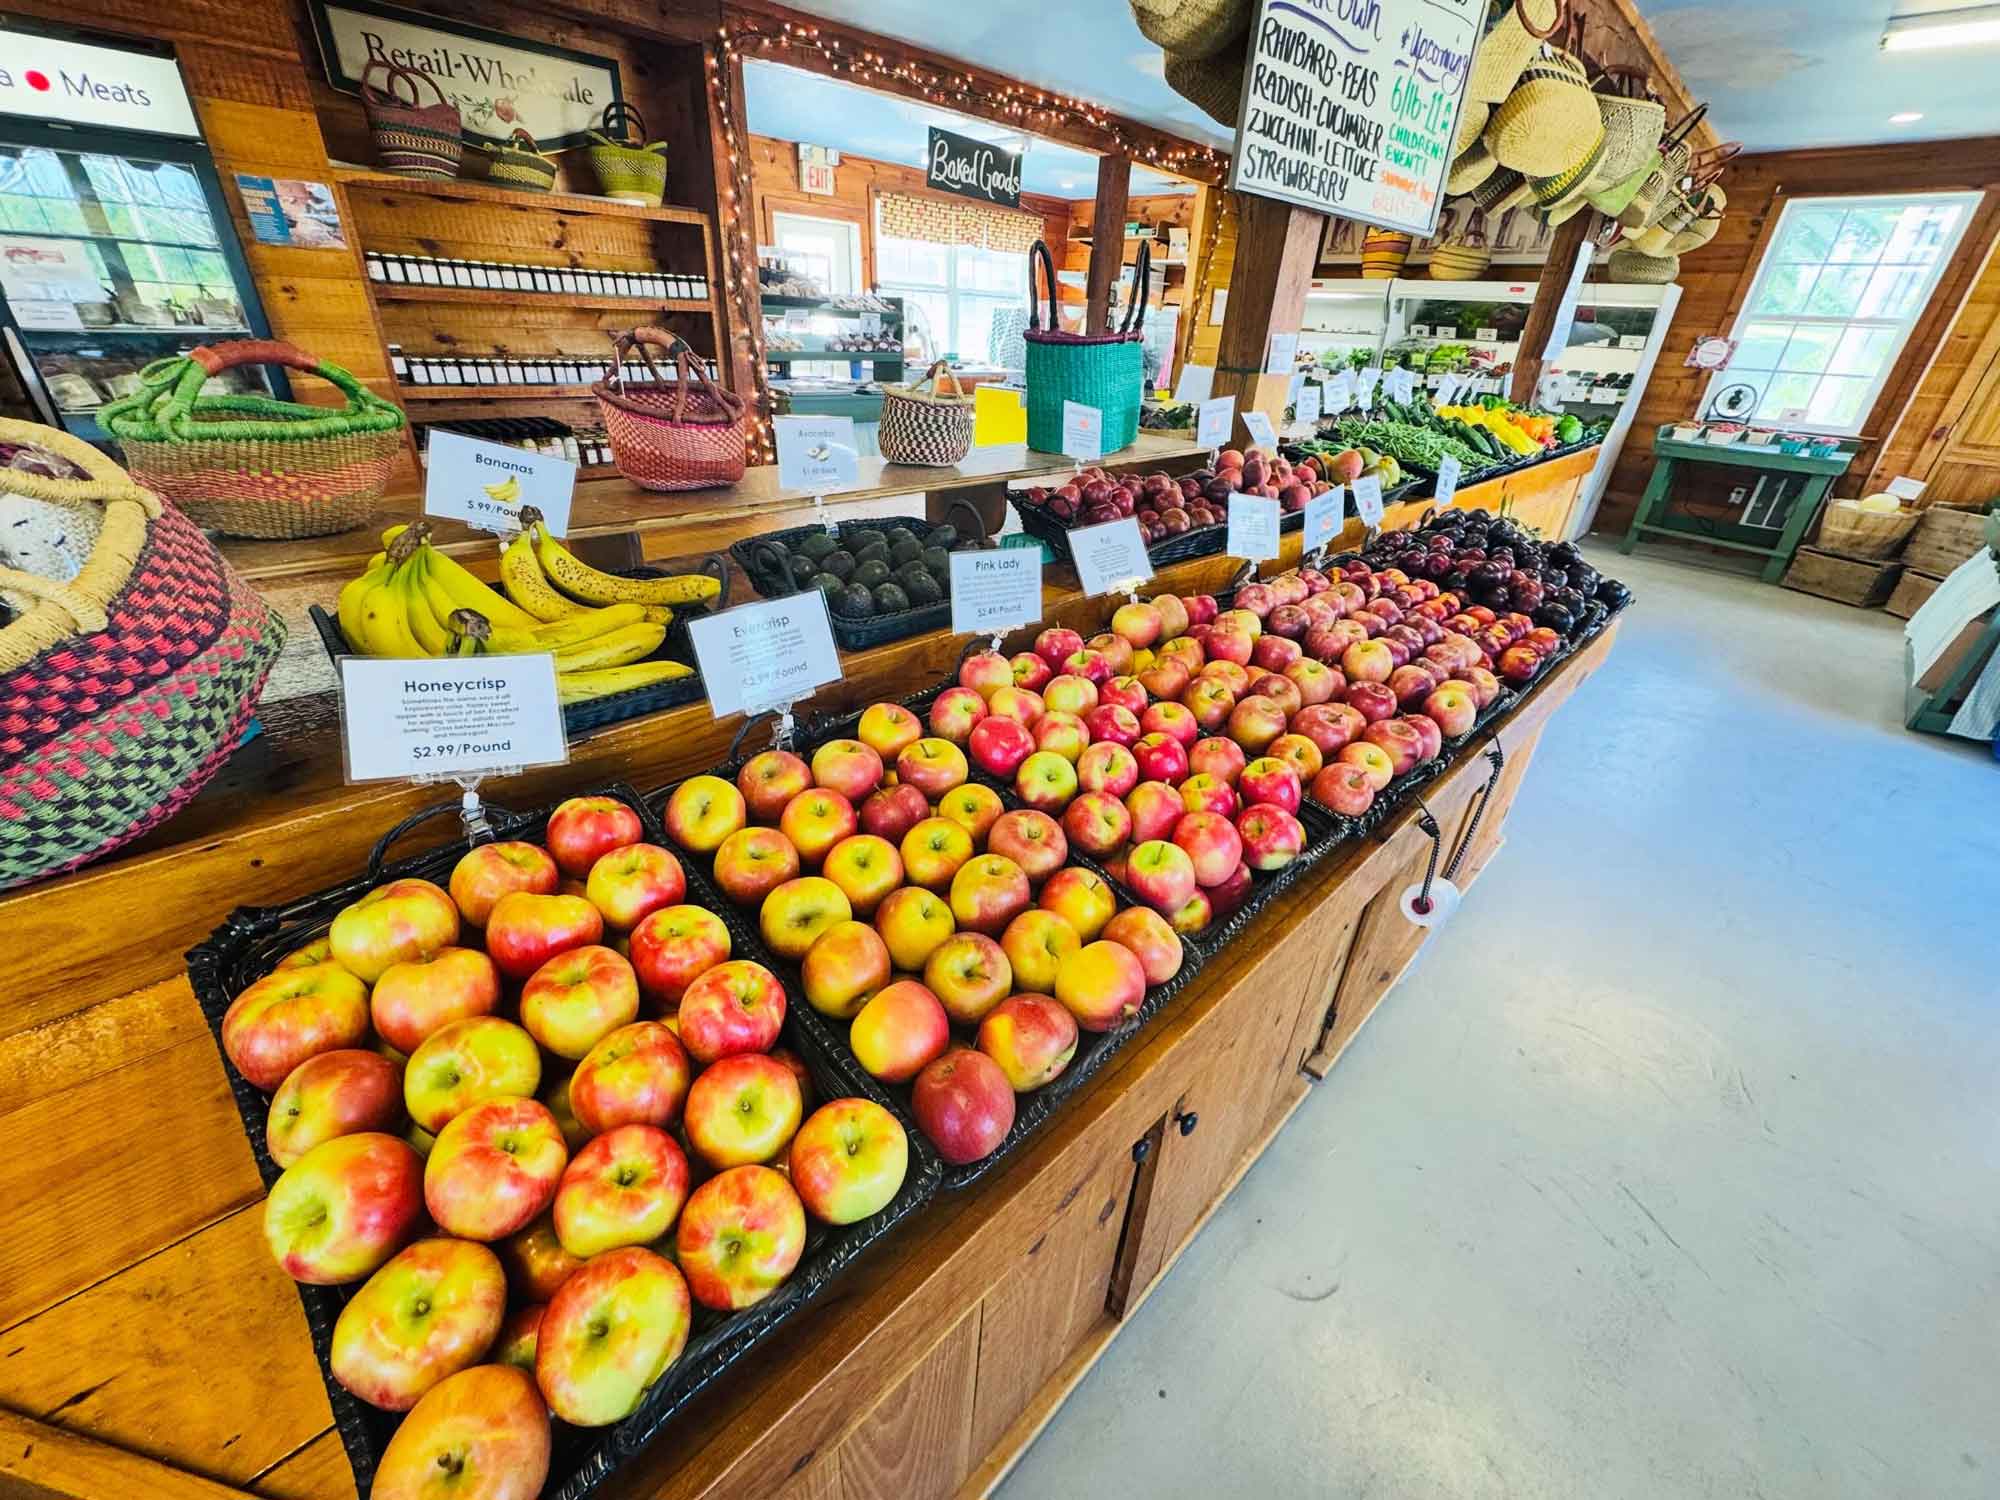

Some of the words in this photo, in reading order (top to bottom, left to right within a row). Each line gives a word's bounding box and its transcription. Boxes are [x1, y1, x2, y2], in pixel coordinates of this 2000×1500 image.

[59, 68, 151, 106] Meats
[1253, 63, 1313, 120] RADISH
[1316, 96, 1384, 158] CUCUMBER
[1247, 108, 1317, 158] ZUCCHINI
[1324, 138, 1379, 183] LETTUCE
[809, 166, 829, 190] EXIT
[931, 139, 978, 189] Baked
[979, 150, 1021, 199] Goods
[1244, 144, 1349, 202] STRAWBERRY
[475, 453, 534, 475] Bananas
[467, 499, 522, 519] $.99/Pou
[975, 559, 995, 571] Pink
[998, 557, 1020, 571] Lady
[404, 676, 507, 693] Honeycrisp
[412, 739, 511, 760] $2.99/Pound
